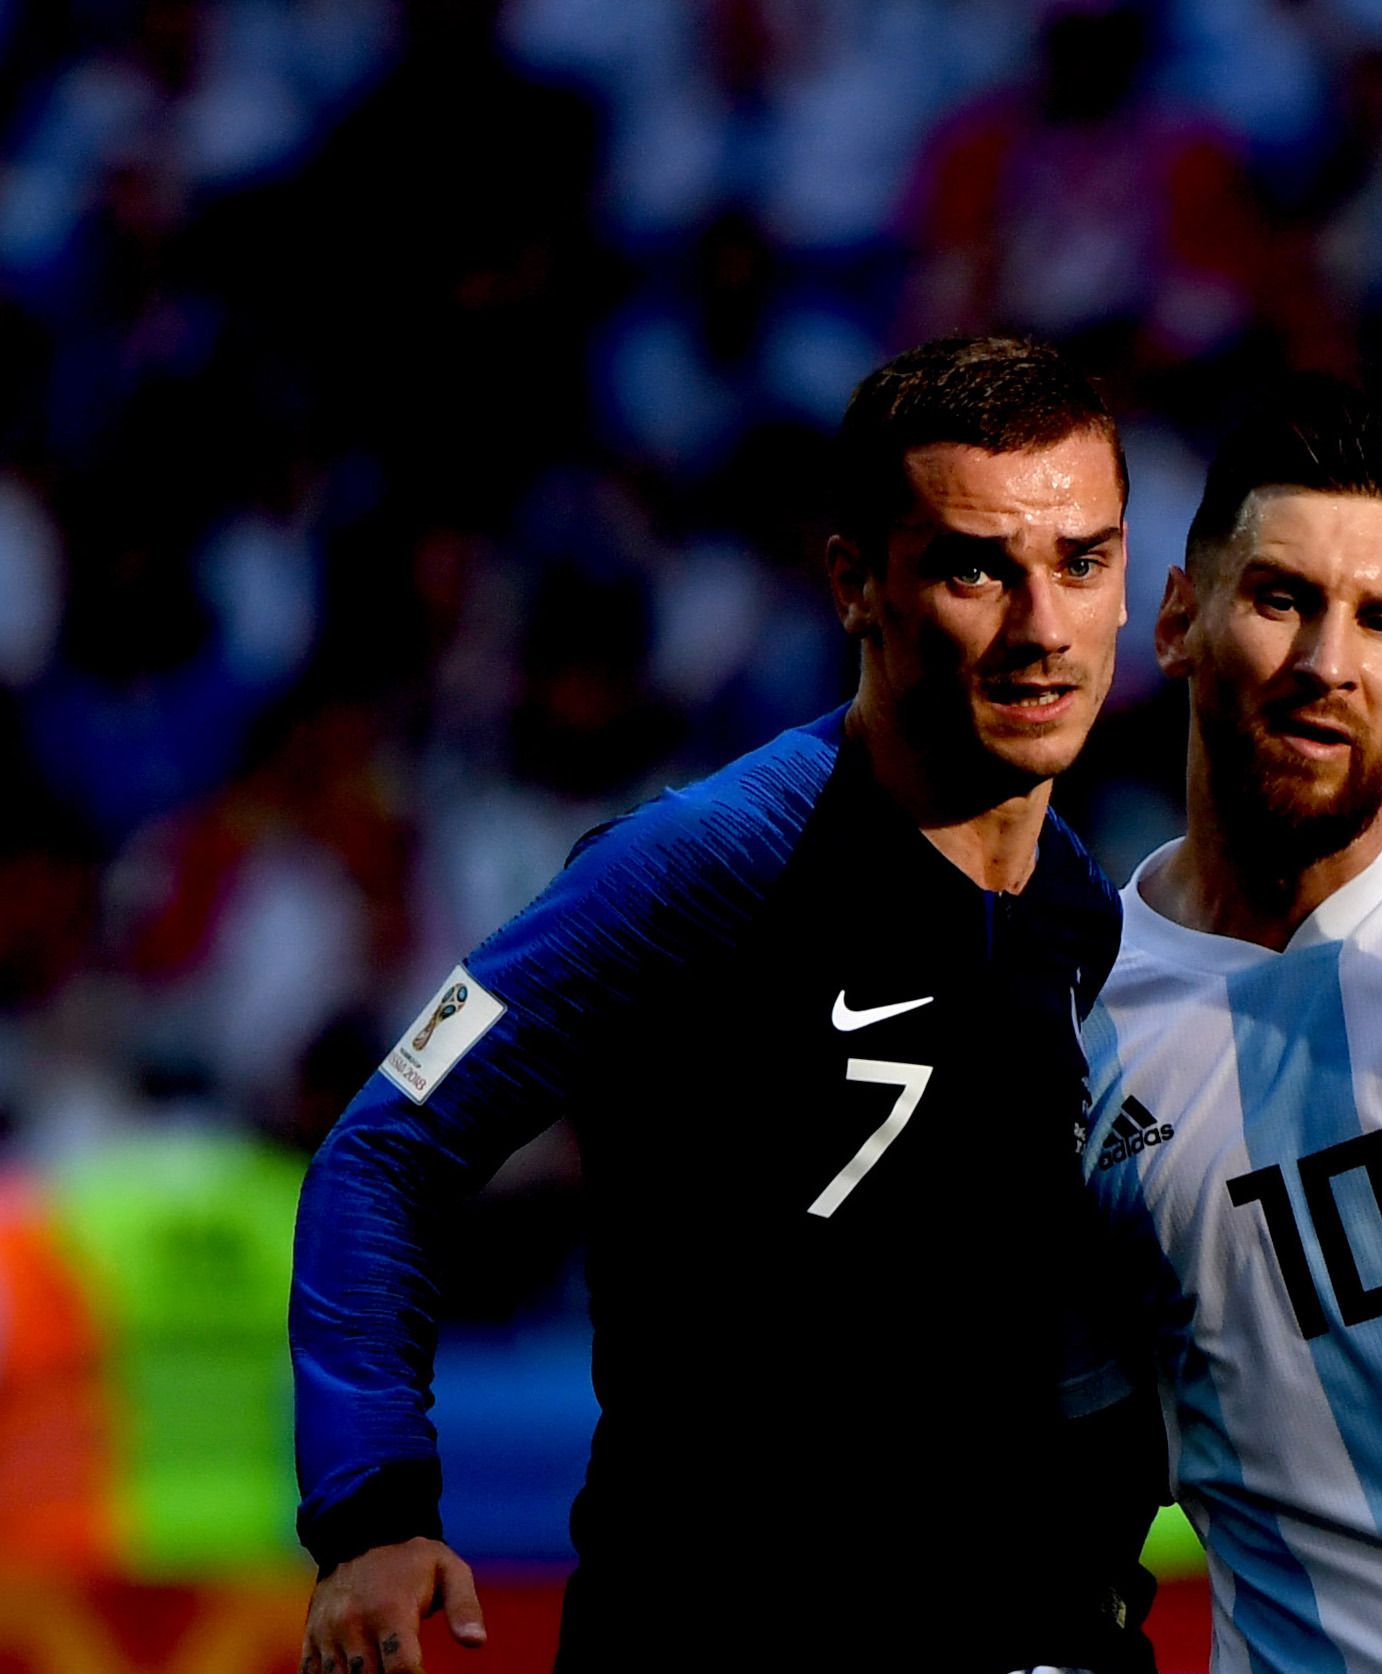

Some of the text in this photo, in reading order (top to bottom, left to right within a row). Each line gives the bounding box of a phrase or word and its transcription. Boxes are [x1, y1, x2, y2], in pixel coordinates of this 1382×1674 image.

[403, 1068, 427, 1091] 2018
[807, 1057, 934, 1219] 7
[1099, 1123, 1175, 1171] adidas
